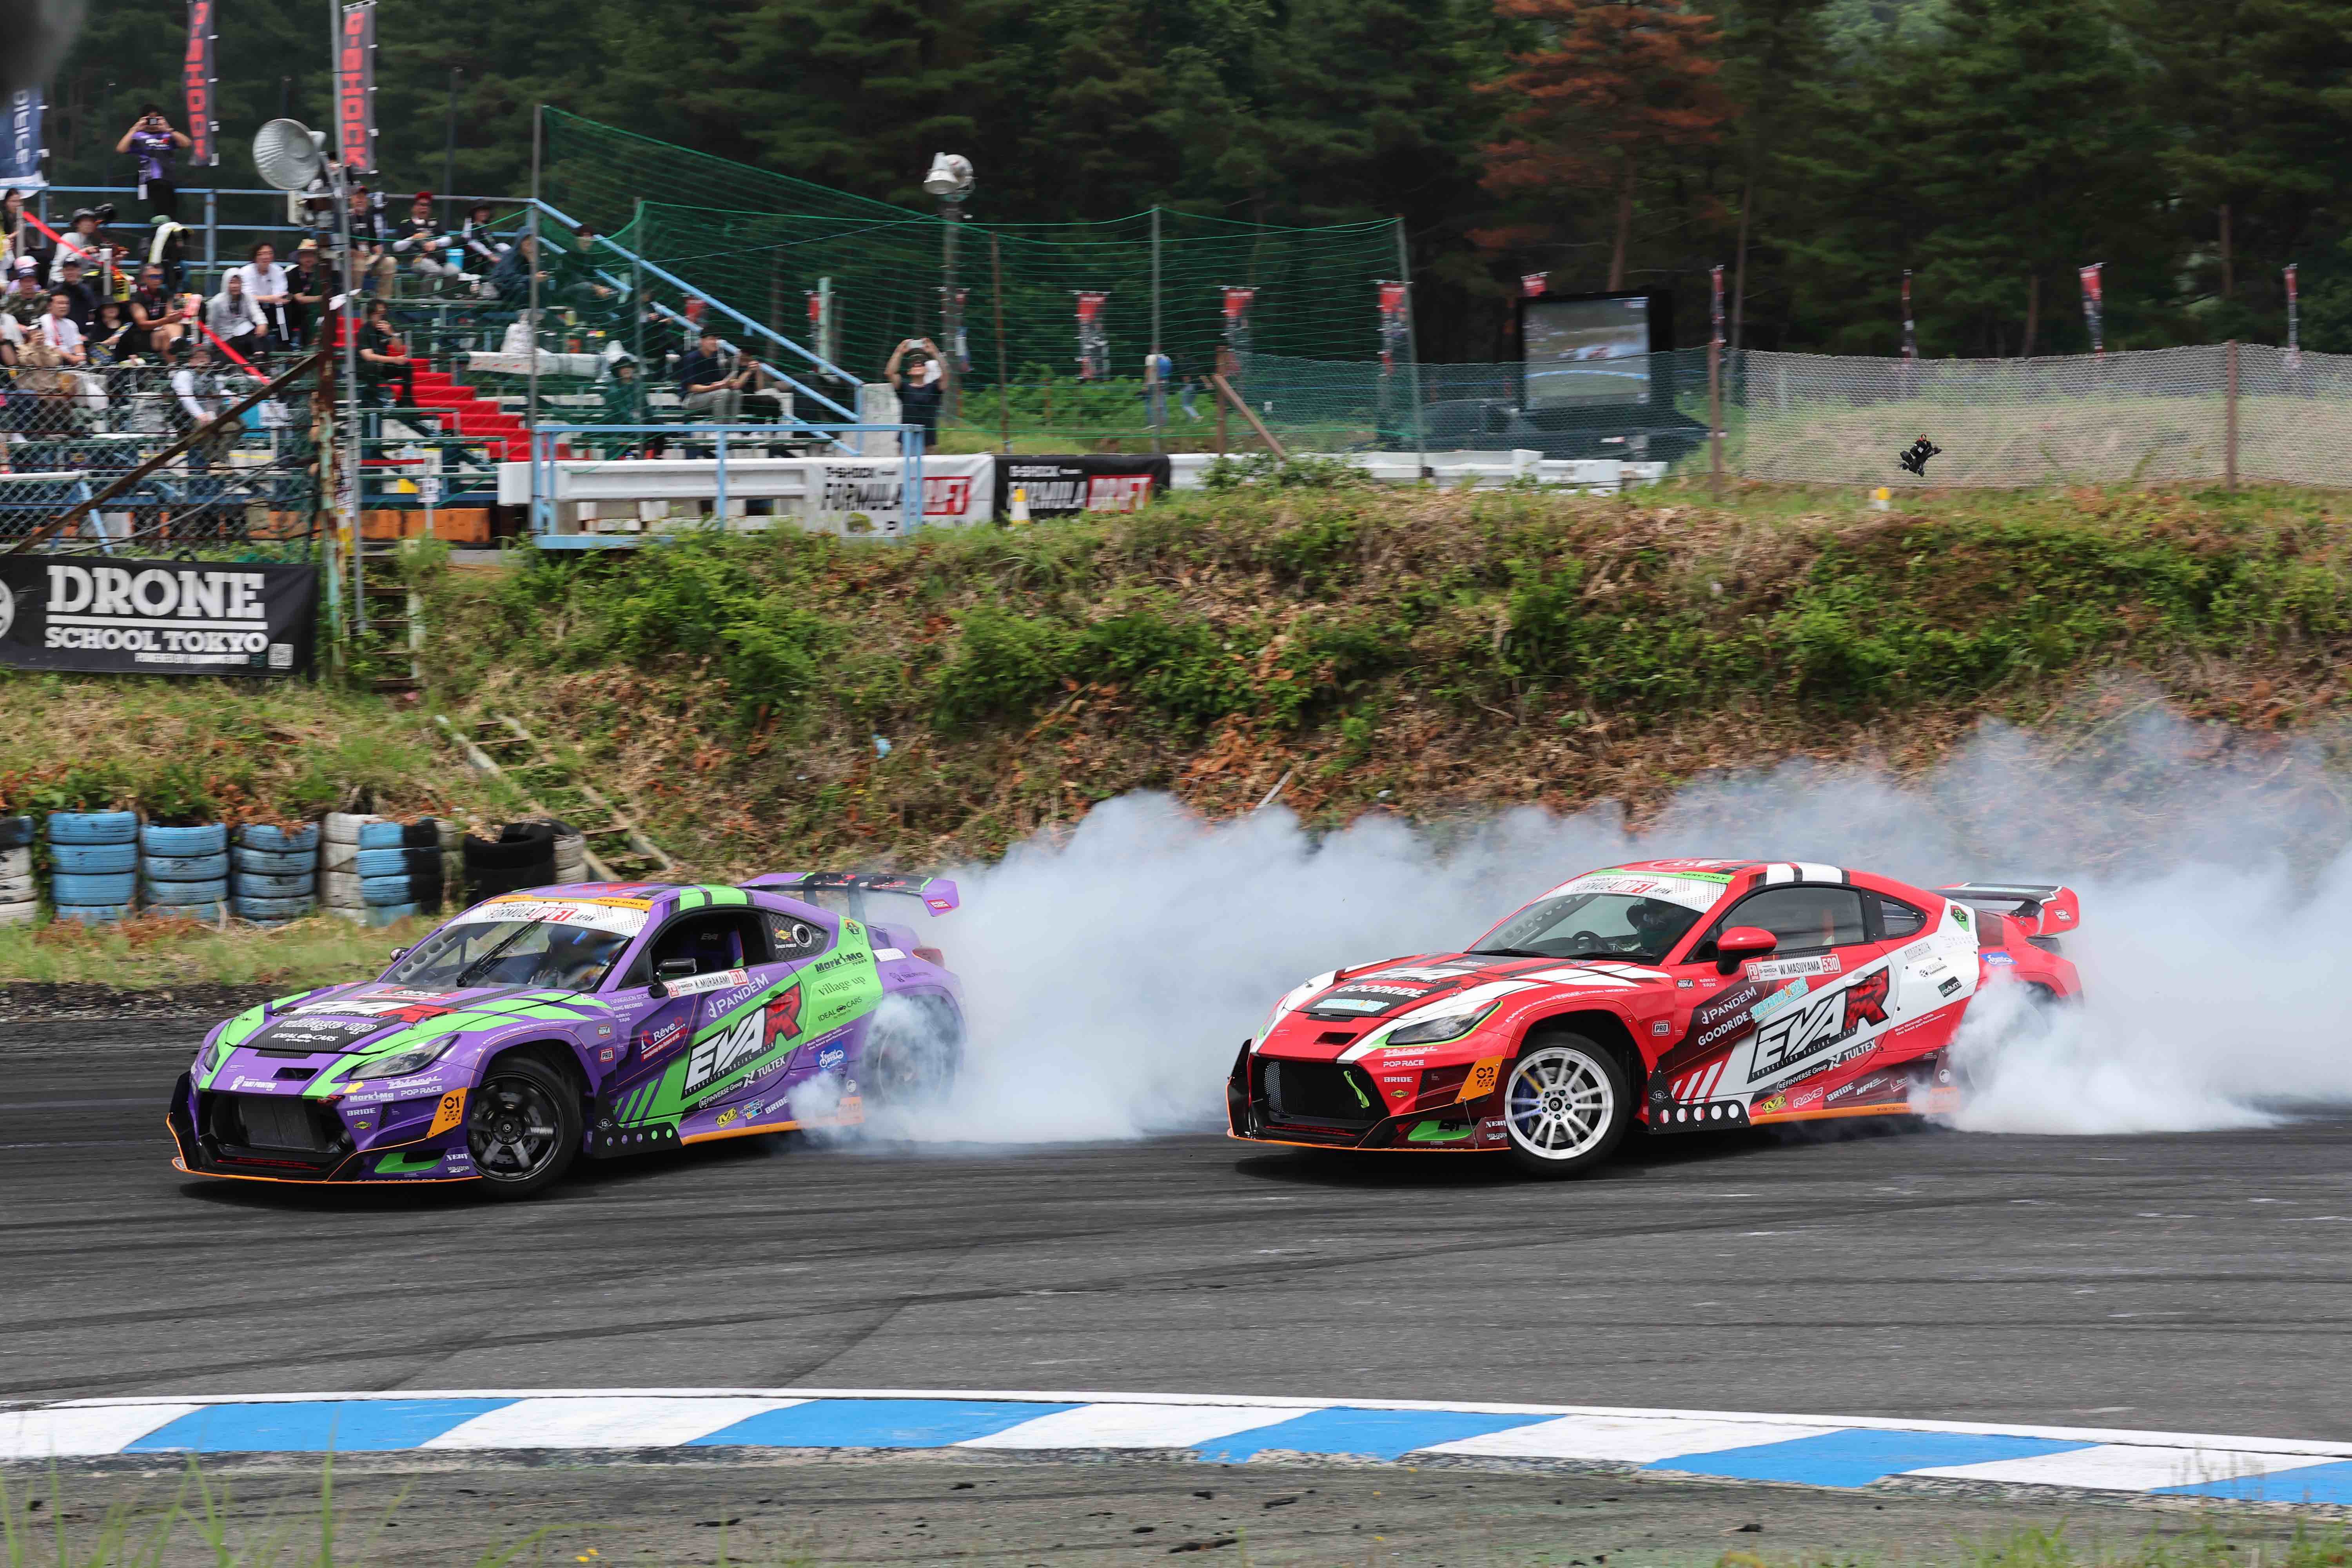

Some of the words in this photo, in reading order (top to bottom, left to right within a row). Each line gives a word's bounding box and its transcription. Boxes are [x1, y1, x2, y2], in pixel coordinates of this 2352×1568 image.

[46, 565, 265, 619] DRONE
[44, 626, 161, 651] SCHOOL
[162, 631, 269, 653] TOKYO
[1778, 960, 1821, 975] W.MASUYAMA
[1823, 956, 1838, 971] 530
[694, 975, 731, 989] K.MURAKAMI
[731, 971, 748, 984] 610
[818, 980, 851, 996] village
[852, 976, 866, 985] up
[716, 973, 769, 1013] PANDEM
[1336, 985, 1428, 998] GOODRIDE
[1942, 981, 1961, 995] radium
[818, 1009, 837, 1022] IDEAL
[846, 996, 862, 1008] CARS
[1708, 985, 1758, 1020] PANDEM
[279, 1018, 347, 1031] village
[344, 1021, 377, 1035] up
[1904, 1018, 1923, 1029] through
[1752, 1054, 1798, 1079] EVANGELION
[1803, 1039, 1830, 1055] RACING
[1838, 1028, 1856, 1039] 2010
[1844, 1039, 1877, 1062] TULTEX
[685, 1071, 725, 1095] EVANGELION
[729, 1055, 753, 1071] RACING
[760, 1042, 775, 1053] 2010
[757, 1055, 786, 1078] TULTEX
[1475, 1066, 1495, 1079] 02
[1779, 1070, 1812, 1089] REFINVERSE
[1812, 1064, 1828, 1074] Group
[419, 1085, 443, 1094] RACE
[701, 1087, 730, 1106] REFINVERSE
[730, 1081, 743, 1091] Group
[1793, 1086, 1824, 1108] RAYS
[1826, 1082, 1855, 1102] BRIDE
[346, 1107, 377, 1116] BRIDE
[444, 1096, 460, 1110] 01
[765, 1096, 789, 1114] BRIDE
